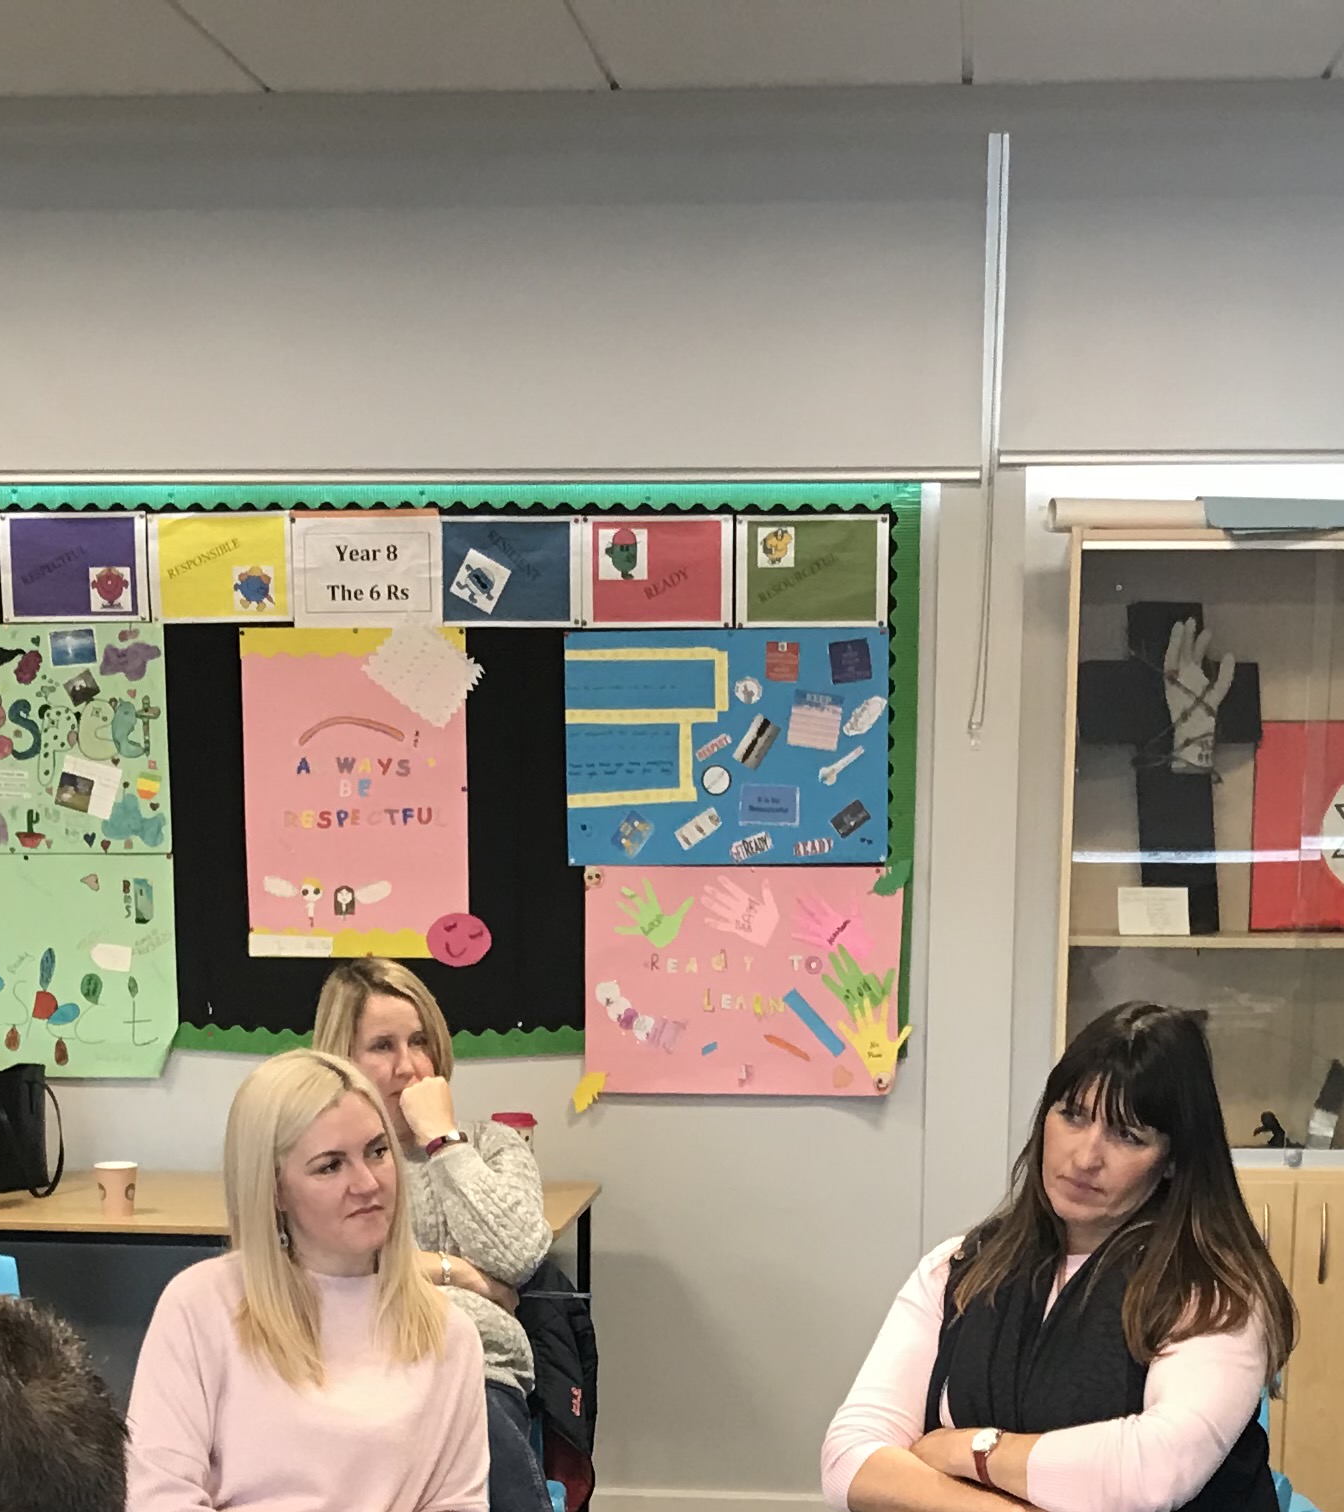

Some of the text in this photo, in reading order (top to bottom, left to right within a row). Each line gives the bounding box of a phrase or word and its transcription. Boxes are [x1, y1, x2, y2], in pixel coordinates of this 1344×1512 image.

[20, 544, 89, 585] RESPECTFUL
[166, 537, 241, 580] RESPONSIBLE
[335, 544, 398, 563] Year 8
[326, 584, 410, 602] The 6 Rs
[644, 566, 690, 601] READY
[757, 552, 841, 605] RESOURCEFUL
[339, 778, 372, 797] BE
[283, 807, 448, 830] RESPECTFUL
